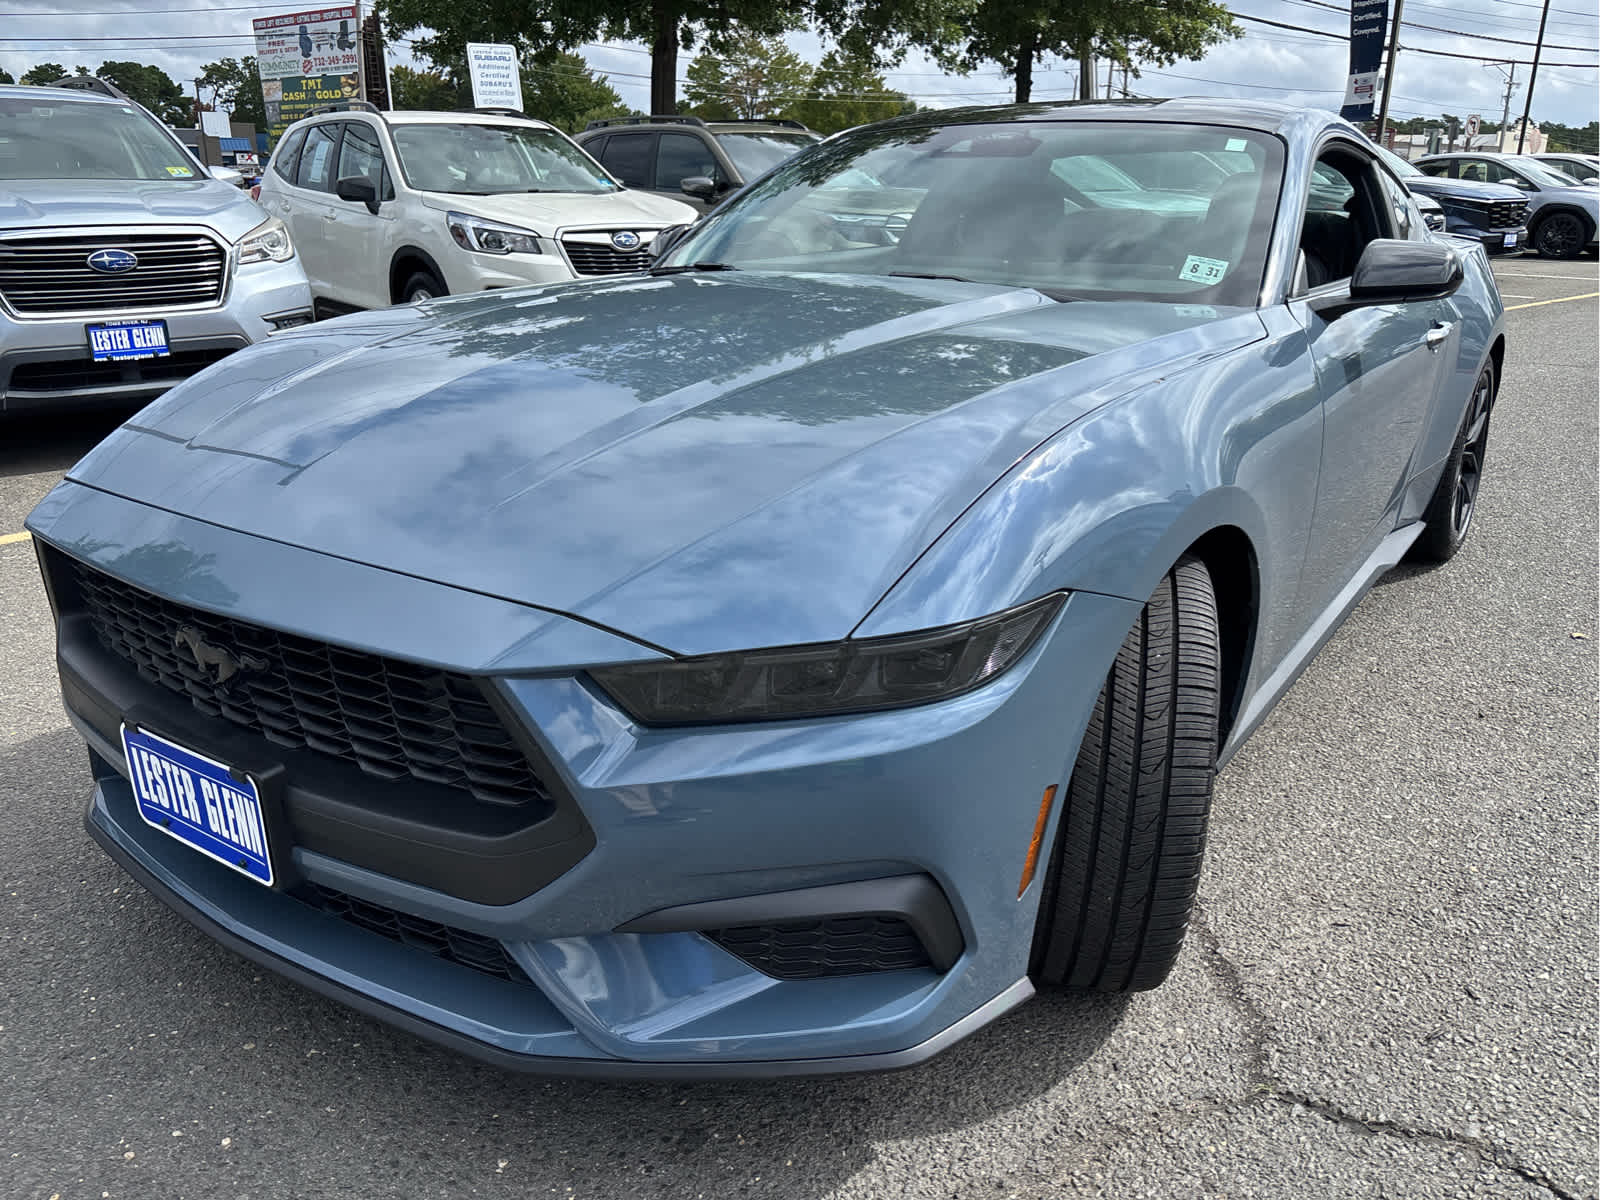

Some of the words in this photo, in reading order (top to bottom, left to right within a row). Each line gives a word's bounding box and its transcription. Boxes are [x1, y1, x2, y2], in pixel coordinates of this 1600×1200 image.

[258, 48, 278, 56] DELIVERY
[260, 60, 300, 73] COMMUNITY
[313, 54, 358, 67] 732-349-2991
[301, 79, 322, 91] TMT
[282, 91, 306, 101] CASH
[316, 90, 342, 99] GOLD
[1190, 263, 1200, 273] 8
[1206, 266, 1219, 278] 31
[90, 329, 131, 351] LESTER
[131, 327, 166, 348] GLENN
[131, 747, 202, 825] LESTER
[200, 777, 264, 857] GLENN
